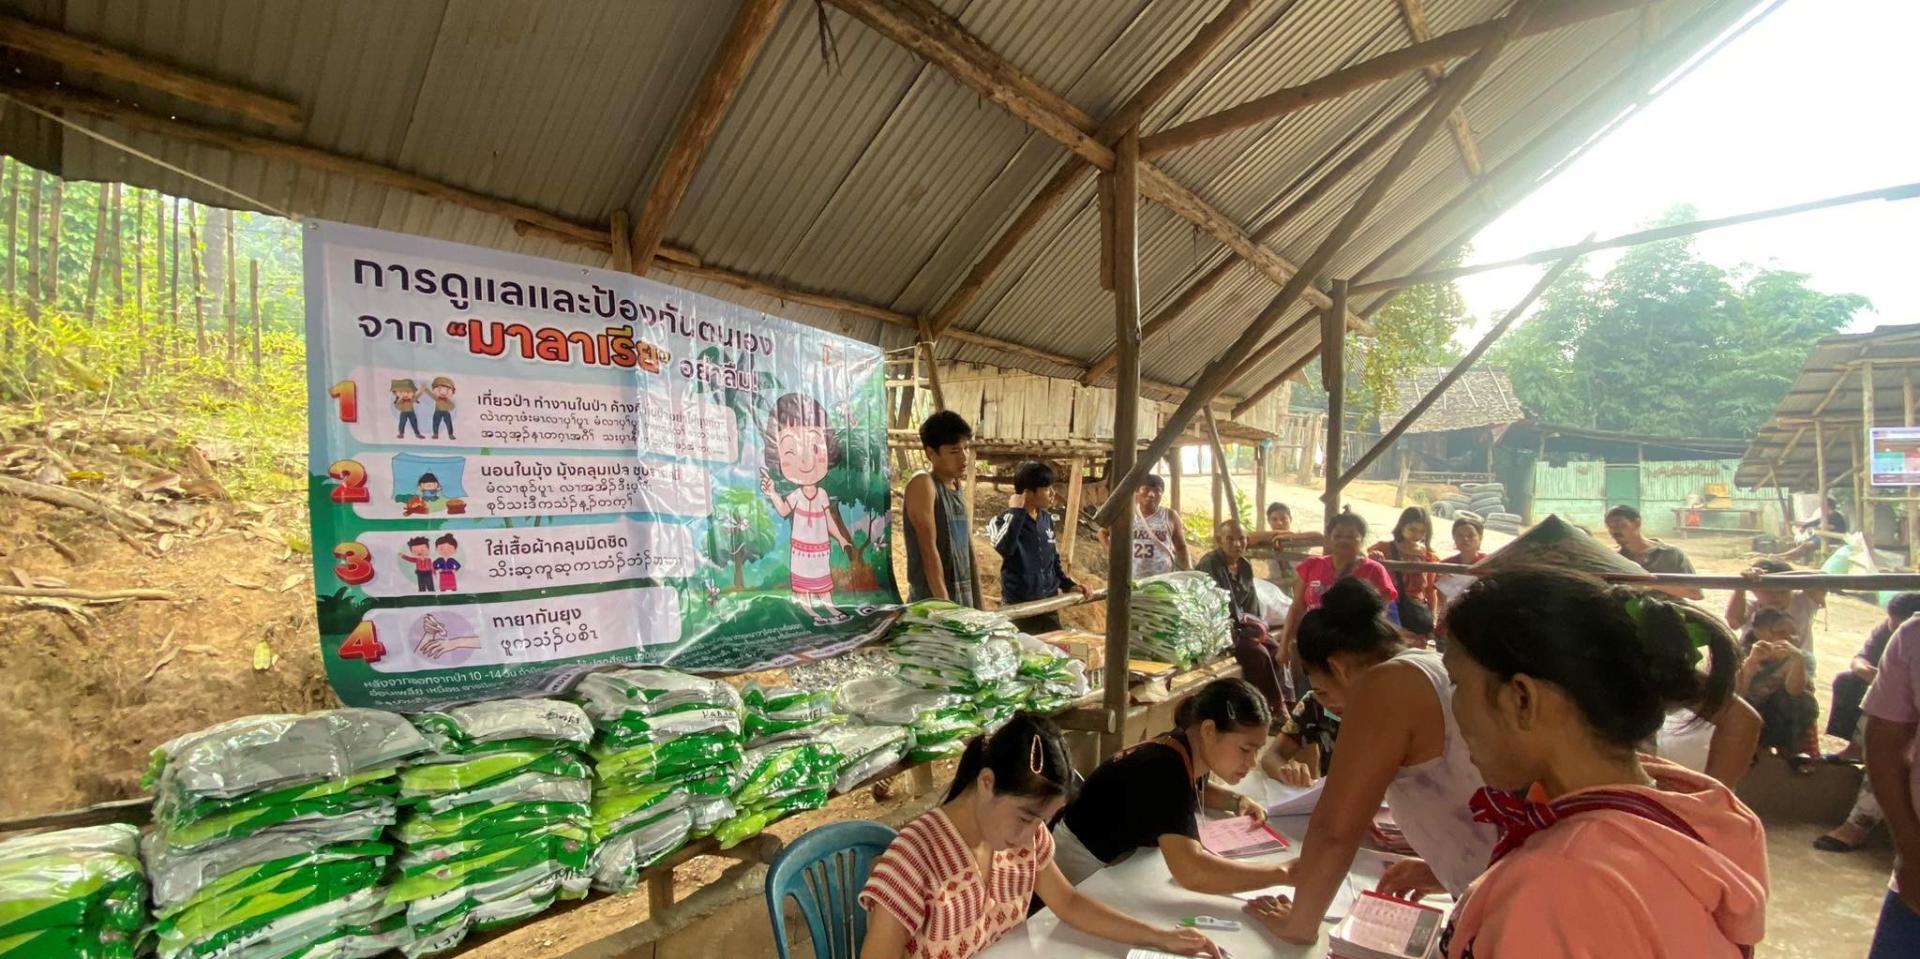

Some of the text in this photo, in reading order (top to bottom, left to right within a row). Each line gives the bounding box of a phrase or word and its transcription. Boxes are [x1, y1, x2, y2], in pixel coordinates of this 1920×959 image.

[354, 258, 774, 356] การดูแลและป้องกันตนเอง
[358, 315, 433, 344] จาก
[328, 380, 358, 423] 1
[478, 389, 530, 407] เที่ยวป่า
[534, 396, 607, 412] ทำงานในป่า
[328, 459, 370, 503] 2
[481, 461, 552, 480] นอนในมุ้ง
[557, 463, 629, 481] มุ้งคลุมเปล
[485, 535, 628, 557] ใส่เสื้อผ้าคลุมมิดชิด
[1134, 543, 1155, 559] 23
[333, 541, 375, 585] 3
[493, 608, 581, 628] ทายากันยุง
[338, 619, 387, 663] 4
[469, 671, 482, 682] 10
